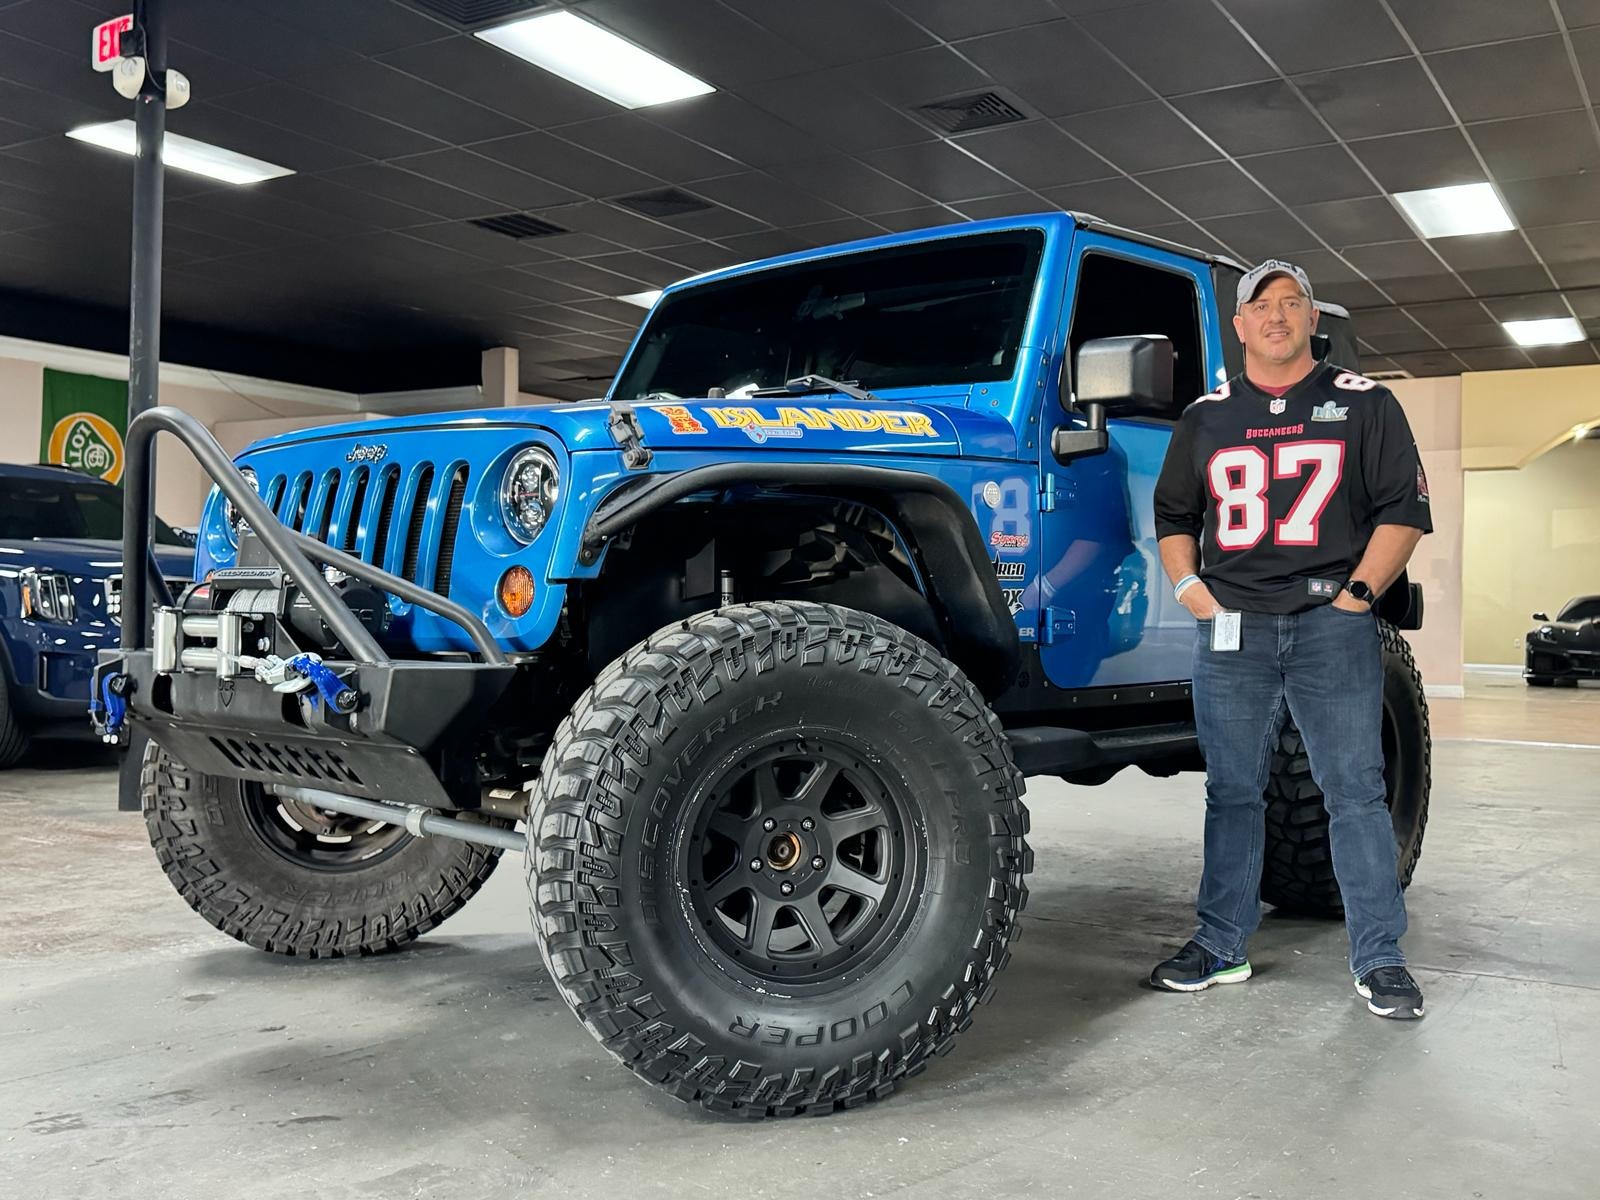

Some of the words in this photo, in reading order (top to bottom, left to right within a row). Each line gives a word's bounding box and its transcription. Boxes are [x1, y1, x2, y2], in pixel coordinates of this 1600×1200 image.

[701, 407, 940, 437] ISLANDER
[1246, 423, 1304, 439] BUCCANEERS
[345, 443, 388, 464] Jeep
[1207, 439, 1346, 551] 87
[728, 979, 914, 1048] COOPER
